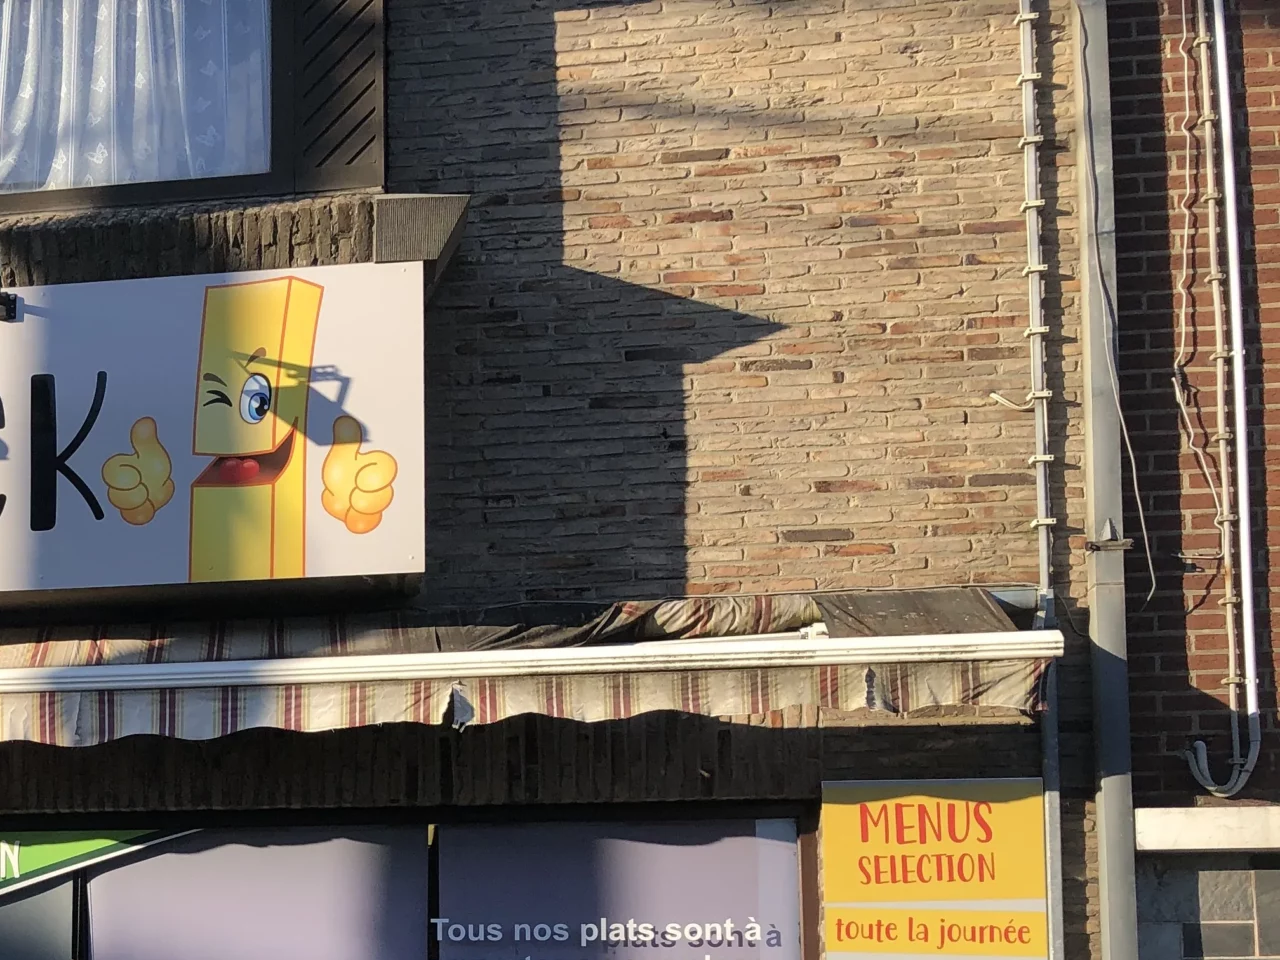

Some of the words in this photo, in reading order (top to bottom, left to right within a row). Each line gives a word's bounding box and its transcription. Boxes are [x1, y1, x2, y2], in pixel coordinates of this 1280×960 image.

[859, 801, 994, 845] MENUS
[858, 852, 996, 885] SELECTION
[430, 917, 503, 941] Tous
[513, 922, 569, 941] nos
[580, 917, 655, 947] plats
[665, 917, 736, 941] sont
[744, 917, 762, 941] à
[835, 918, 898, 942] toute
[908, 917, 929, 943] la
[936, 918, 1031, 949] journée
